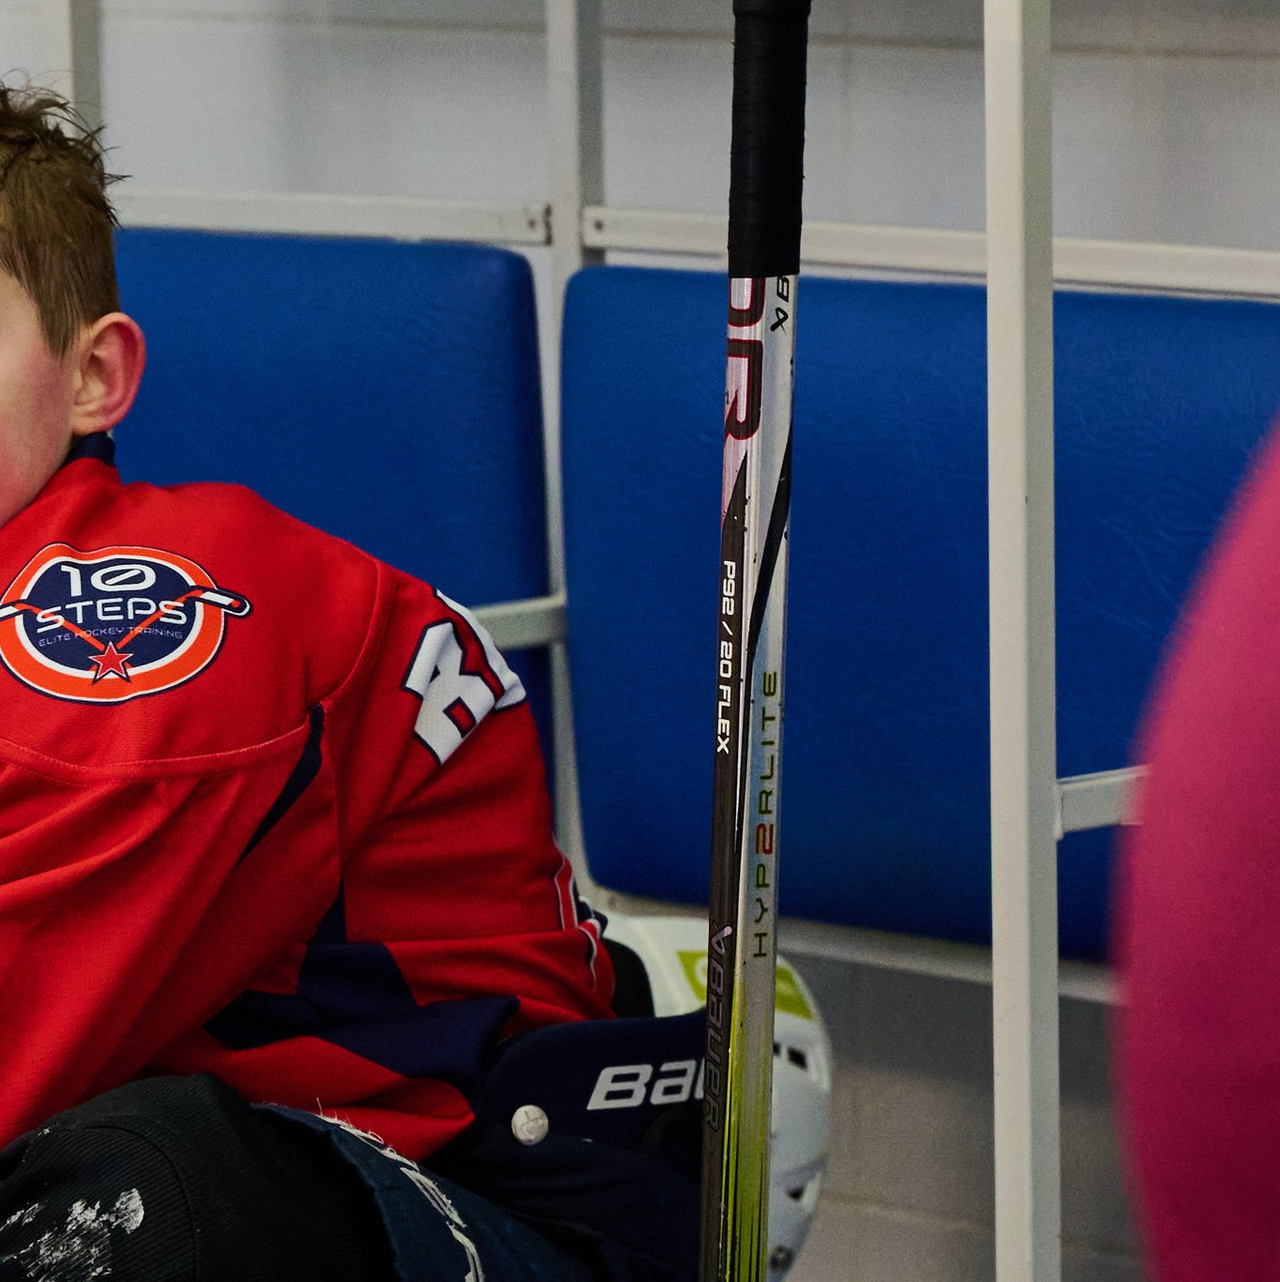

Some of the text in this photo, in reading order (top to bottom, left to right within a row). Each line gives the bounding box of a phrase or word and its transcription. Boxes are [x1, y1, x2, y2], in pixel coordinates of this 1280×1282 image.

[60, 563, 157, 598] 10
[721, 560, 736, 614] P92
[36, 597, 188, 634] STEPS
[39, 626, 183, 647] ELITE HOCKEY TRAINING
[719, 640, 735, 678] 20
[716, 683, 732, 754] FLEX
